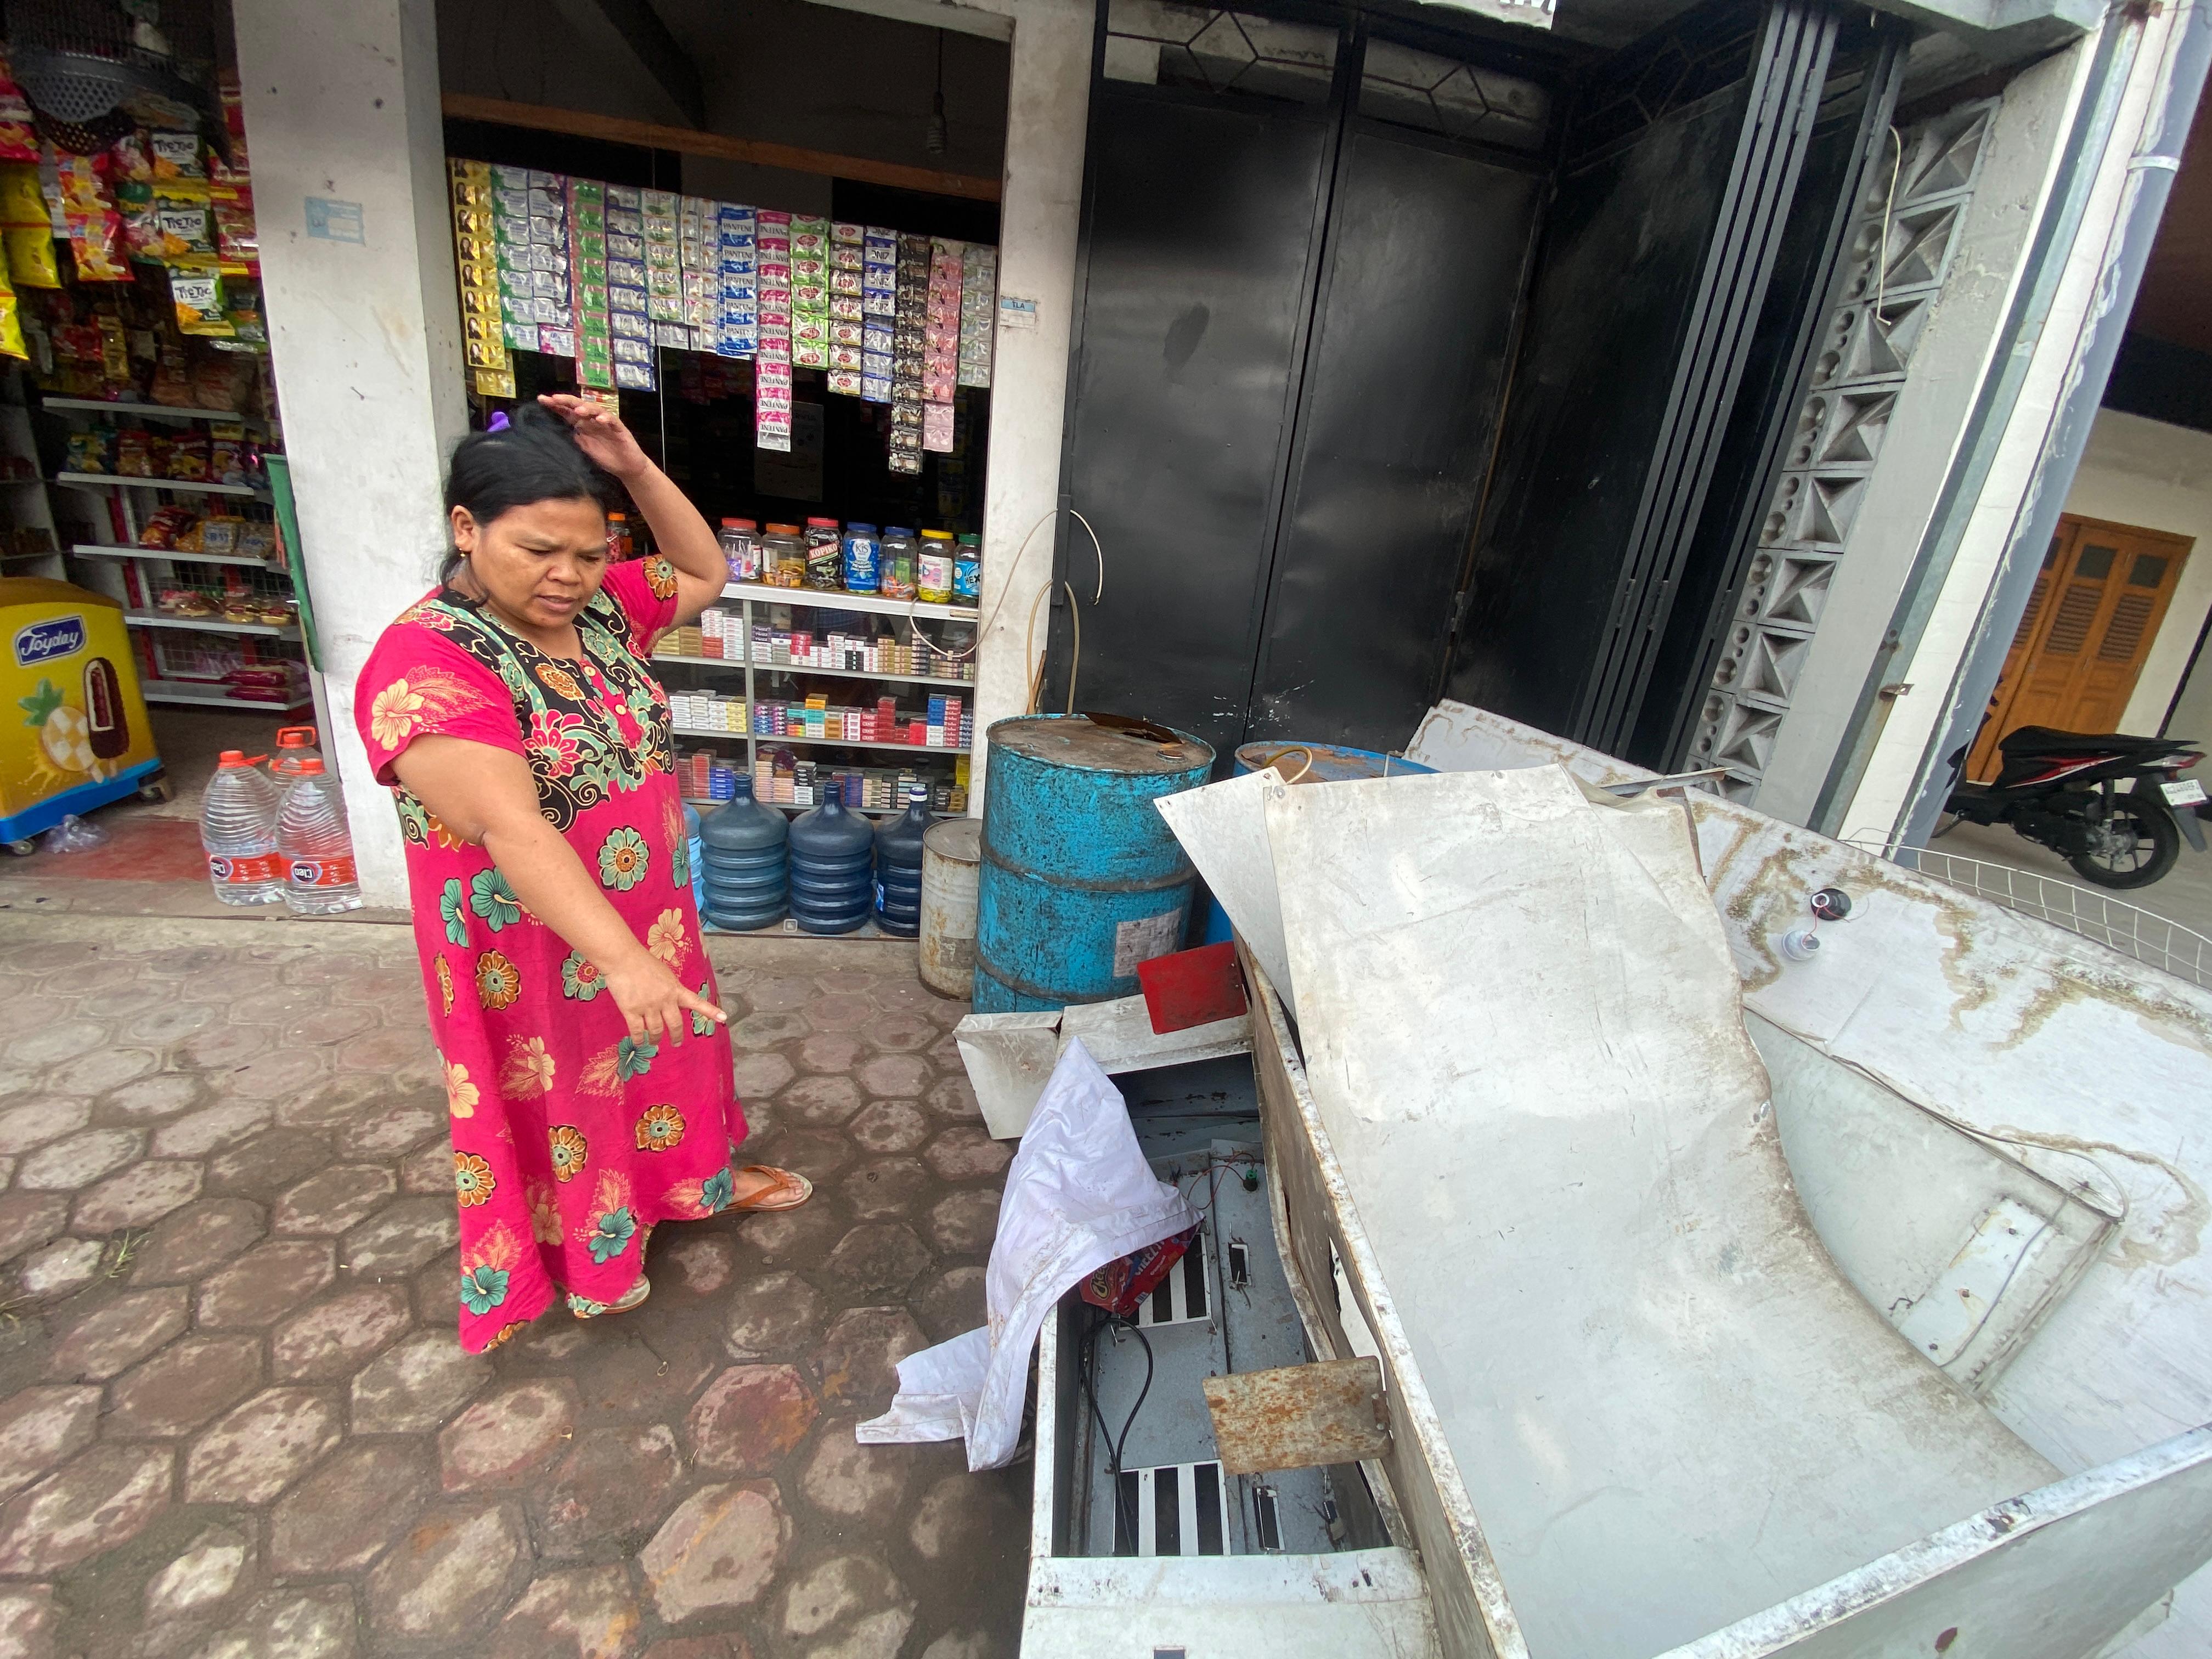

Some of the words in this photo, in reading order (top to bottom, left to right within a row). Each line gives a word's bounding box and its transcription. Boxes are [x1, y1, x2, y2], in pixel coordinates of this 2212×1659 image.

[723, 222, 753, 232] PANTENE
[759, 225, 789, 236] PANTENE
[724, 249, 753, 259] PANTENE
[759, 252, 789, 262] PANTENE
[726, 276, 754, 285] PANTENE
[759, 278, 789, 288] PANTENE
[760, 326, 788, 336] PANTENE
[760, 352, 788, 362] PANTENE
[760, 376, 788, 386] PANTENE
[760, 400, 788, 409] PANTENE
[760, 424, 788, 433] PANTENE
[809, 543, 837, 558] KOPIKO
[21, 630, 78, 656] Joyday
[294, 868, 313, 878] Cleo
